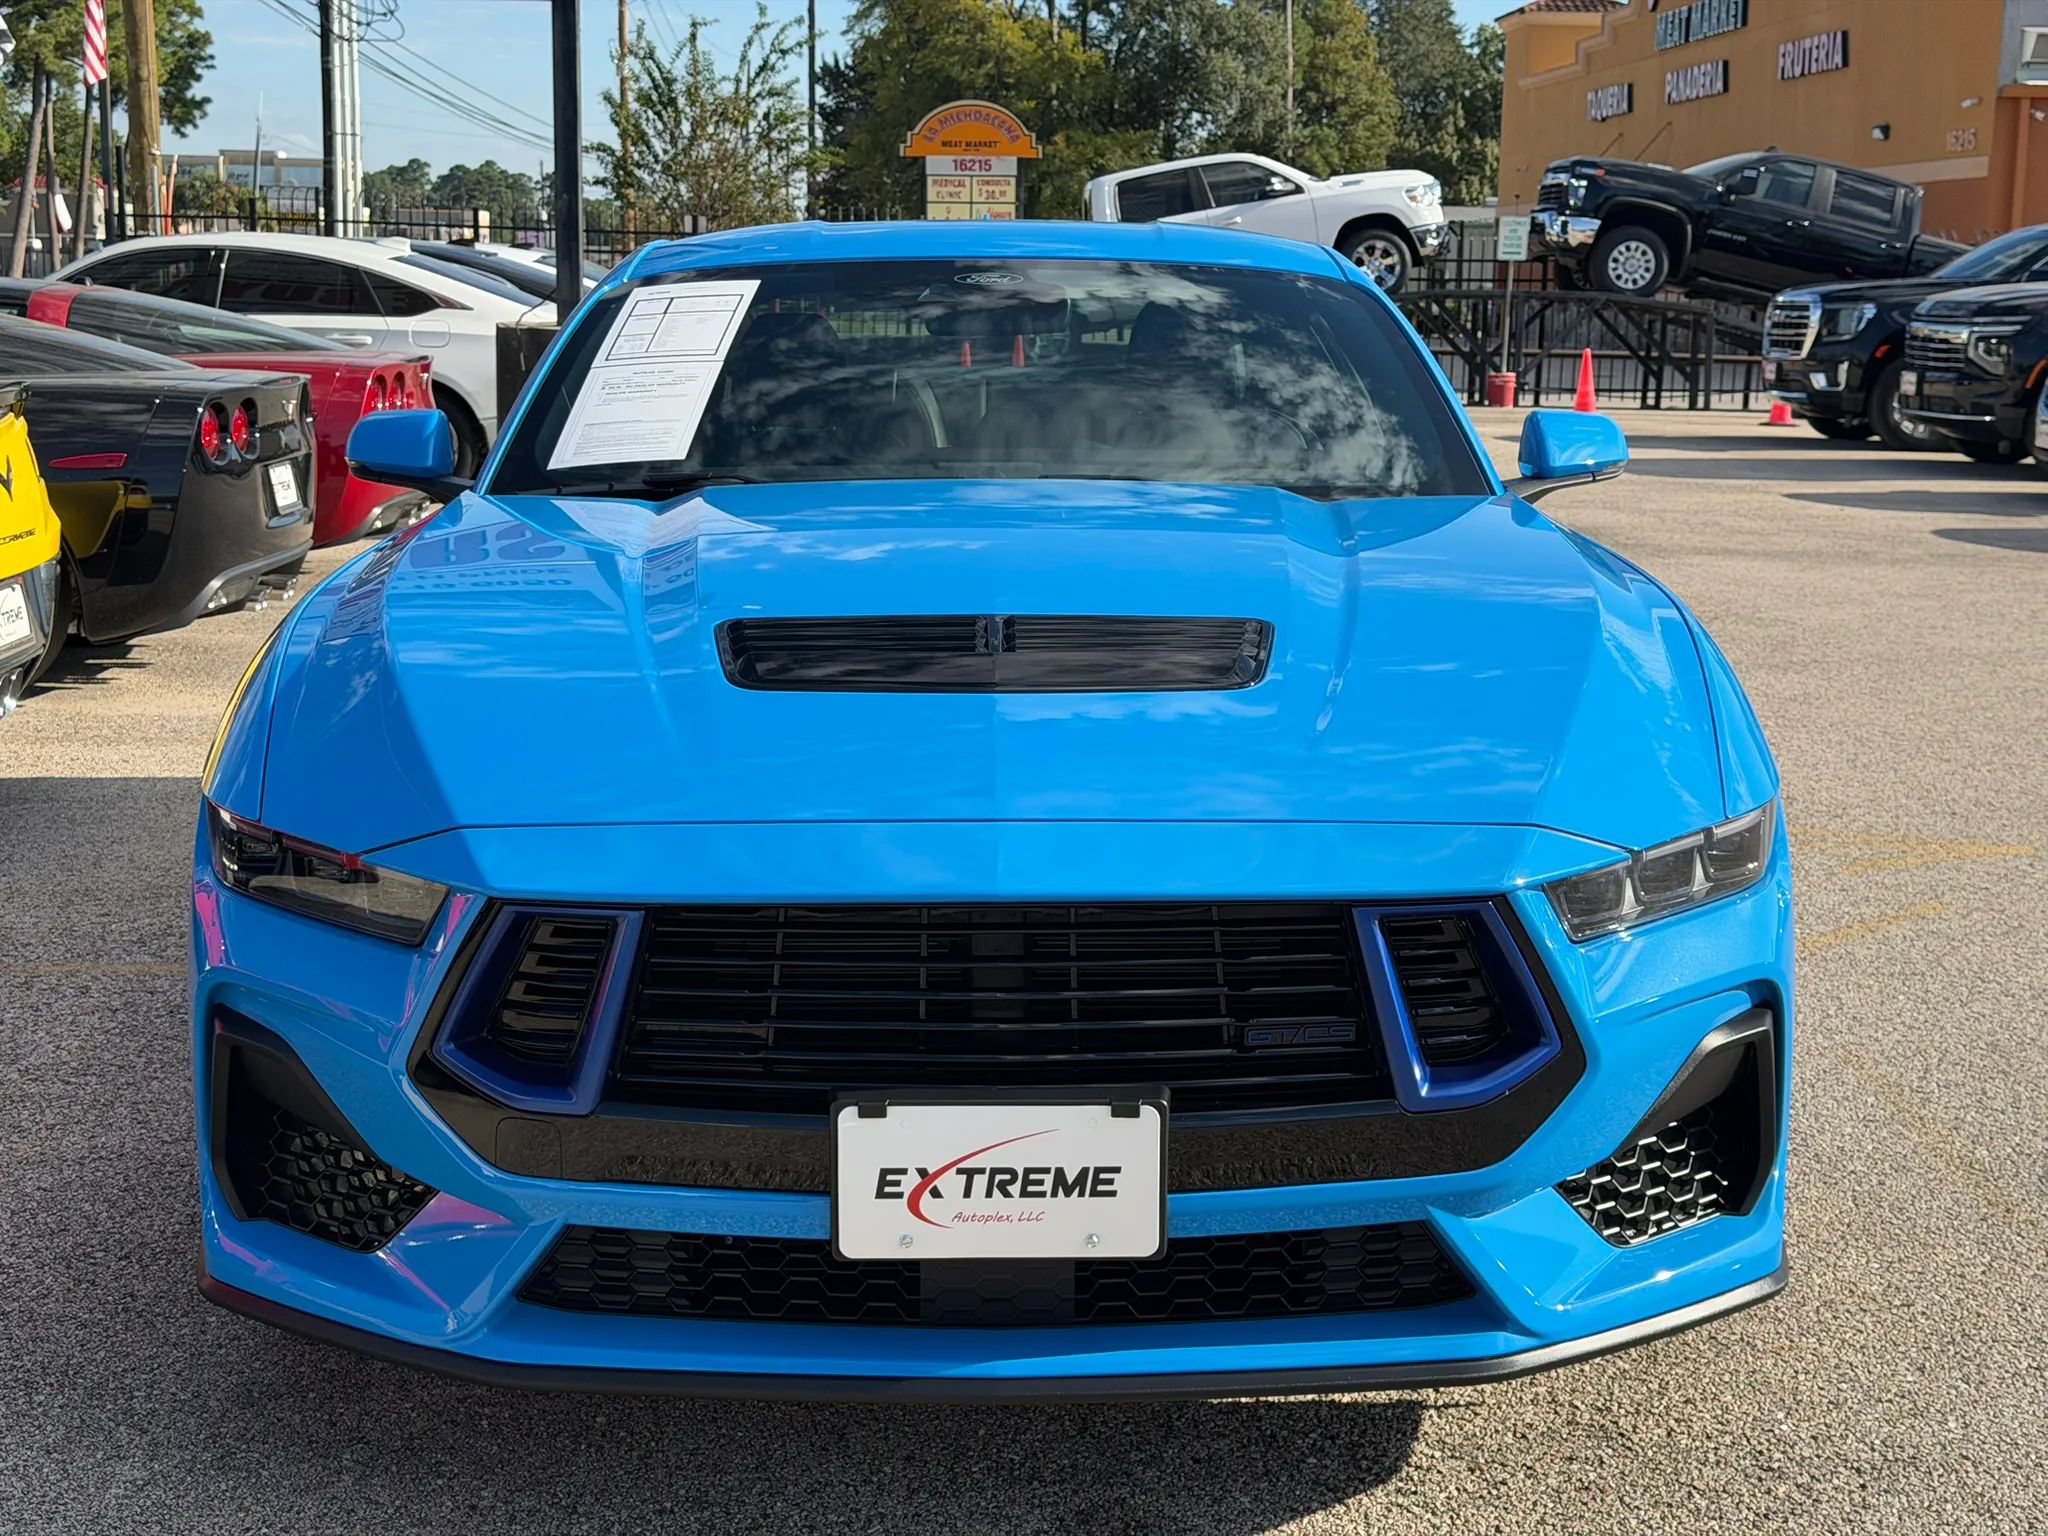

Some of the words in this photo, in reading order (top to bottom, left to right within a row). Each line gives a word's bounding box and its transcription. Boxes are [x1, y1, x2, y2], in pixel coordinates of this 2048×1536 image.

[1777, 30, 1844, 80] FRUTERIA
[1665, 59, 1725, 104] PANADERIA
[941, 140, 962, 148] MEAT
[965, 140, 998, 148] MARKET
[952, 159, 992, 172] 16215
[874, 1166, 1122, 1200] EXTREME
[951, 1210, 1014, 1225] Autoplex,
[1018, 1211, 1046, 1223] LLC
